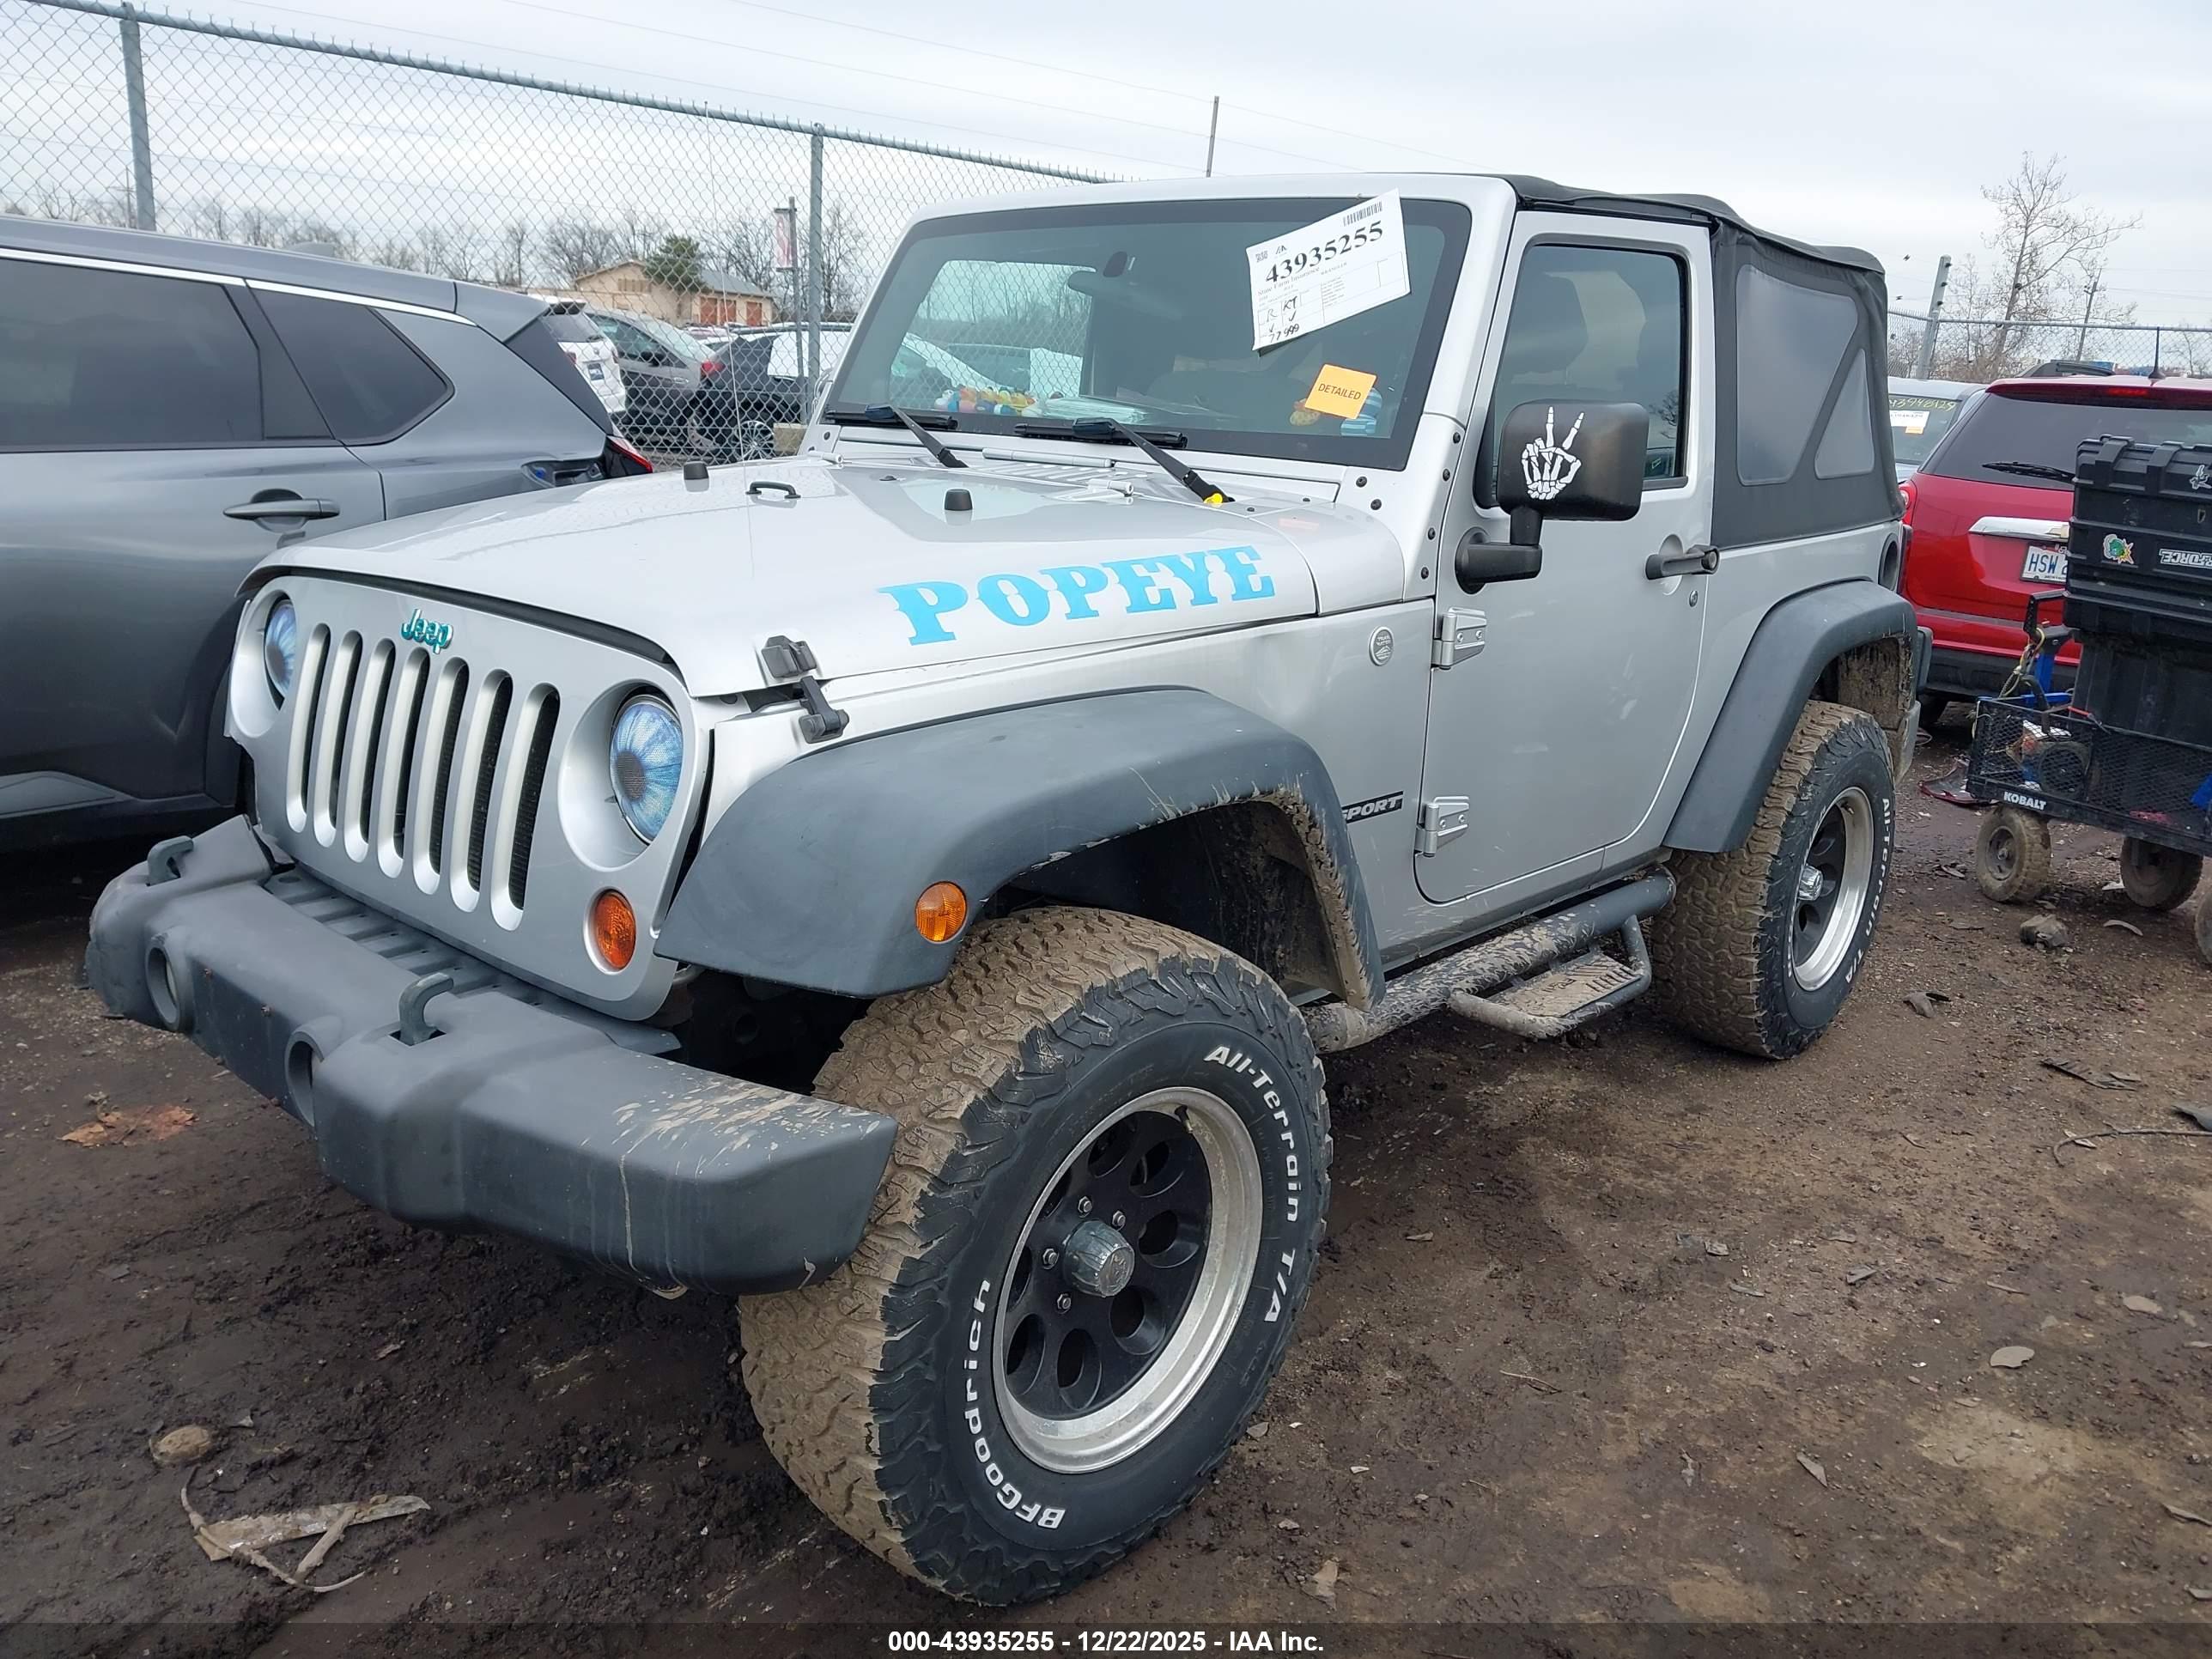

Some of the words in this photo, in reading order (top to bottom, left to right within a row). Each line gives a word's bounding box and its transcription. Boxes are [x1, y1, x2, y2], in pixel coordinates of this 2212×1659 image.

[1266, 219, 1382, 283] 43935255
[1318, 383, 1362, 400] DETAILED
[876, 545, 1276, 646] POPEYE
[2027, 553, 2059, 574] HSW
[401, 609, 453, 654] Jeep
[2003, 791, 2047, 811] KOBALT
[1865, 798, 1891, 937] All-Terrain
[1203, 1045, 1302, 1222] All-Terrain
[1264, 1248, 1296, 1322] T/A
[963, 1279, 1066, 1529] BFGoodrich
